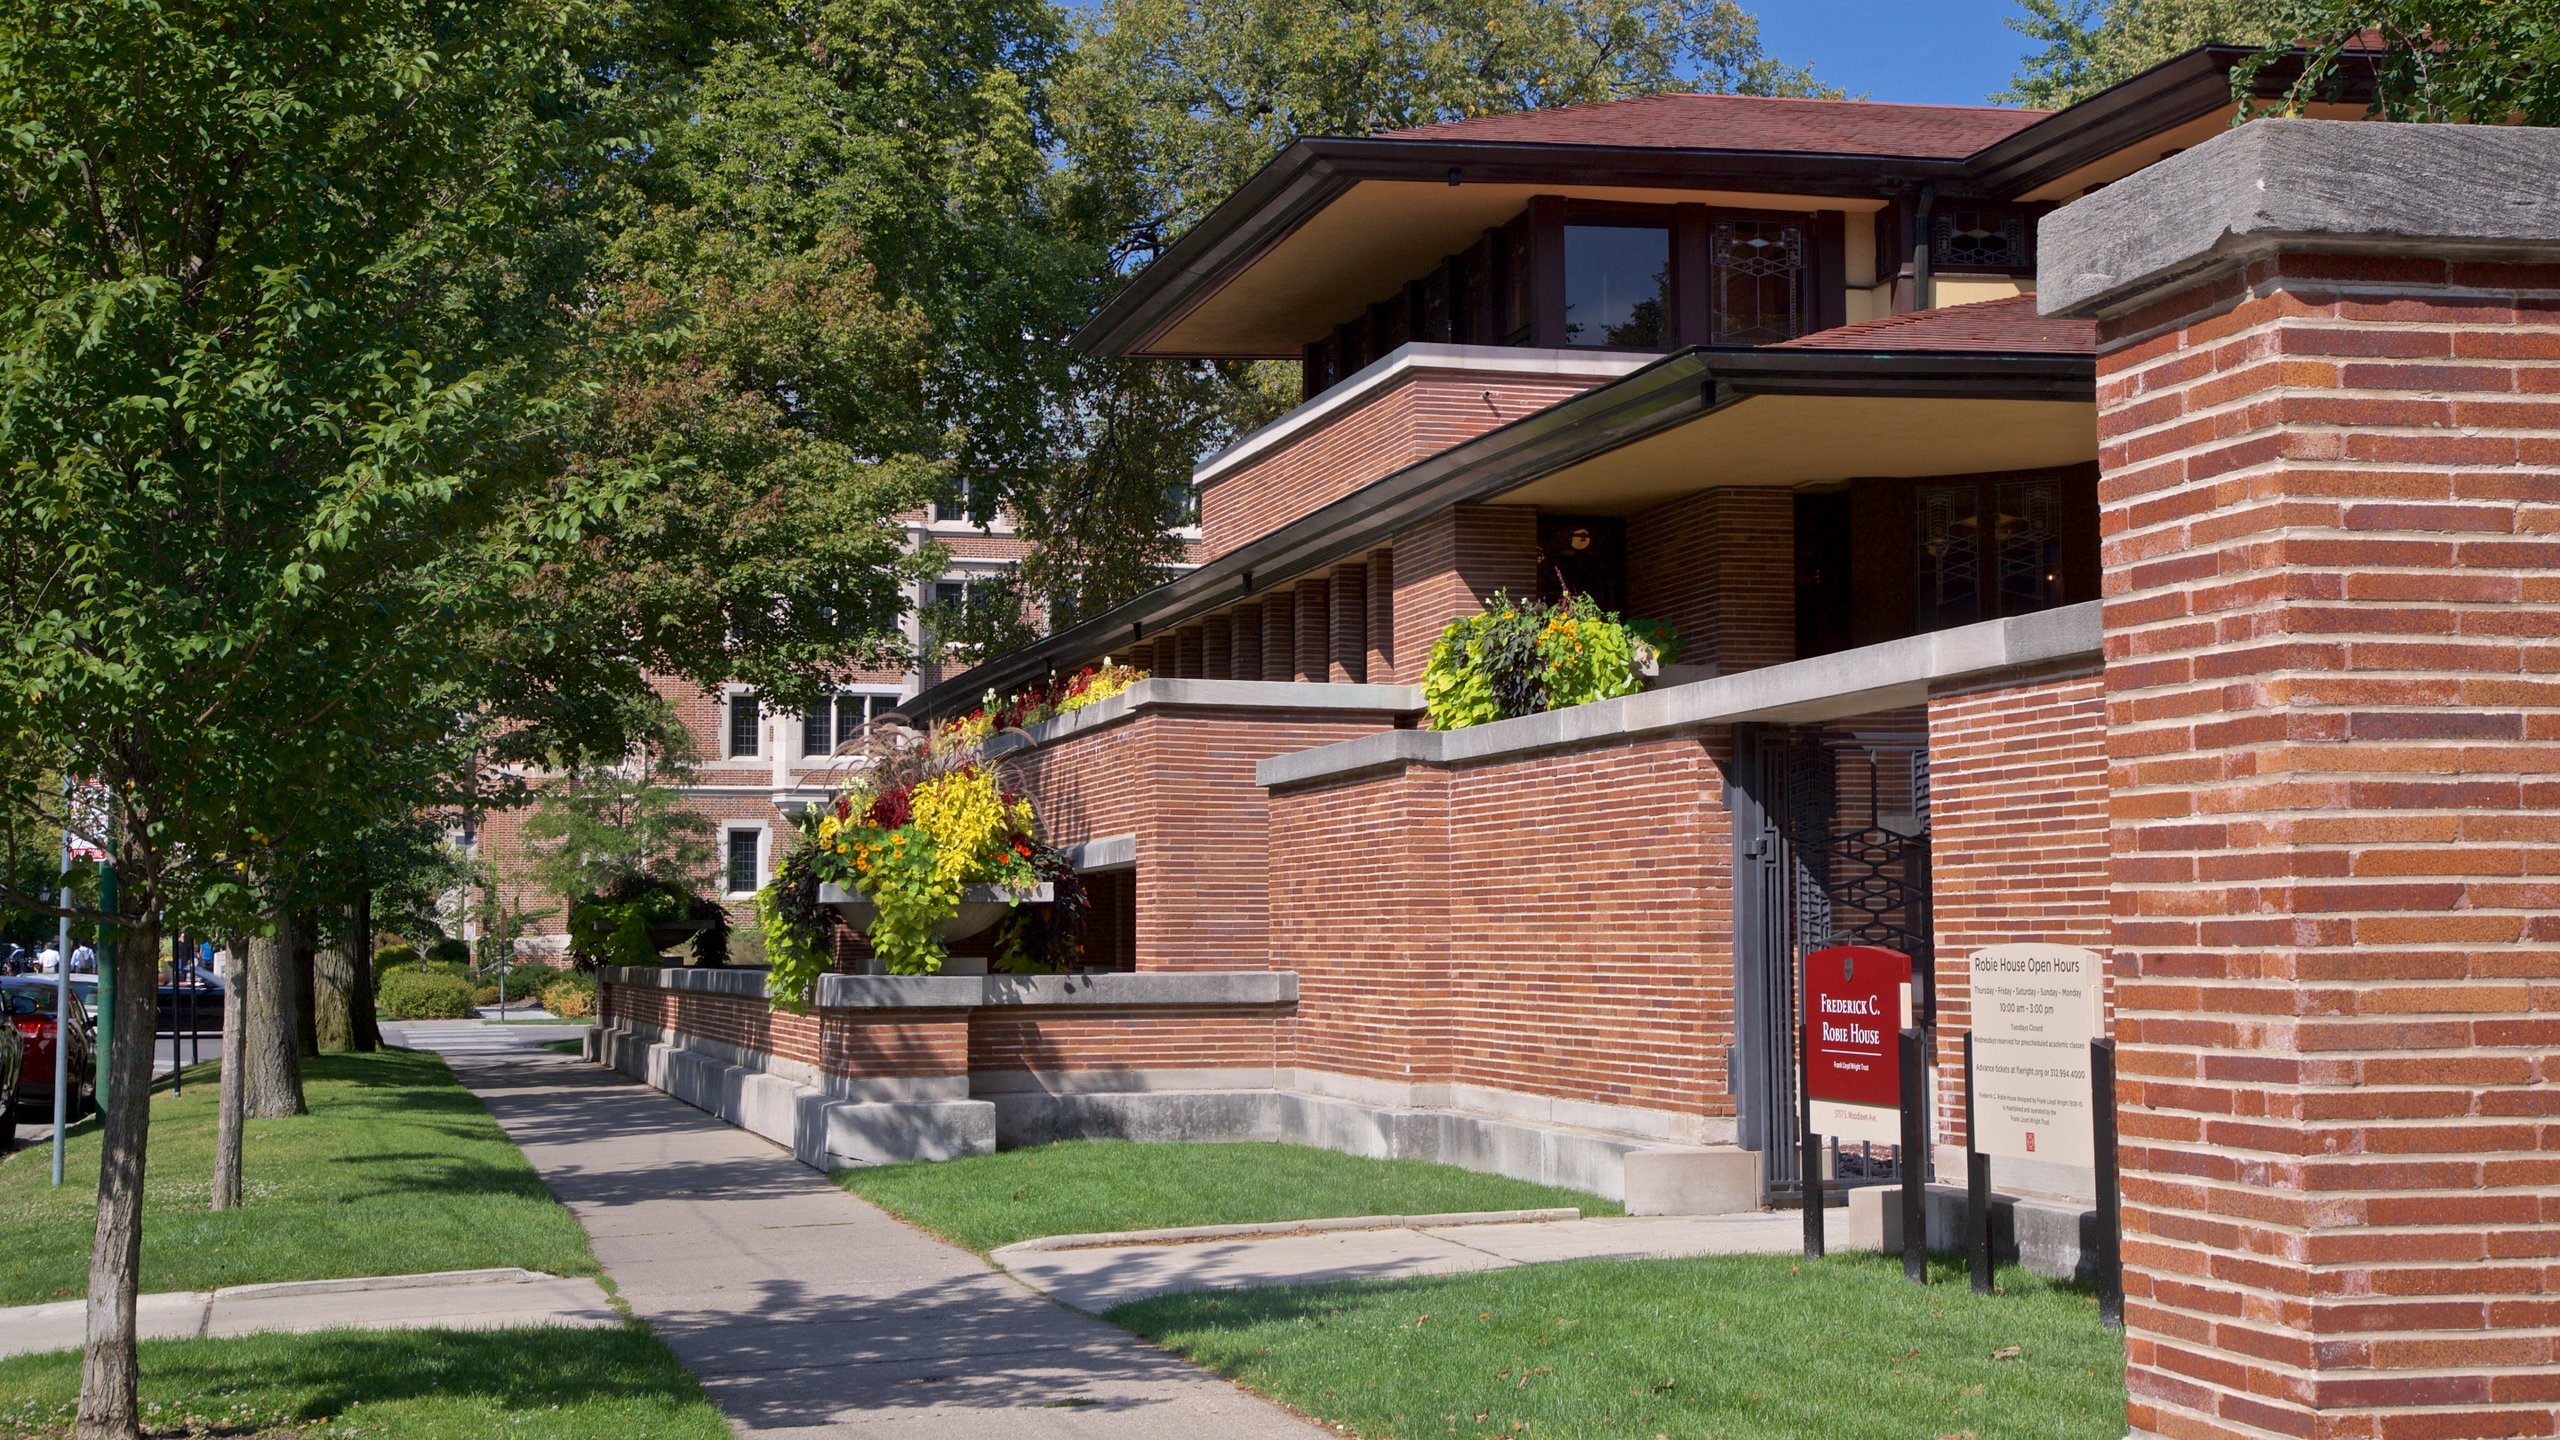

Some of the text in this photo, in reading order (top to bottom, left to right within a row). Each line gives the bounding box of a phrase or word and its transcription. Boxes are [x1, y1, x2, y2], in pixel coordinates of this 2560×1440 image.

[1975, 957, 2079, 975] Robie House Open Hours
[1975, 986, 1994, 996] Thursday
[1998, 987, 2011, 996] Friday
[2015, 987, 2036, 997] Saturday
[2040, 988, 2057, 997] Sunday
[2062, 989, 2081, 998] Monday
[1821, 994, 1880, 1015] FREDERICK C.
[2000, 1002, 2015, 1013] 10:00
[2016, 1005, 2025, 1013] am
[2030, 1003, 2043, 1014] 3:00
[2044, 1006, 2054, 1016] pm
[1823, 1022, 1880, 1044] ROBIE HOUSE
[2010, 1023, 2043, 1033] Tuesdays Closed
[1974, 1036, 1997, 1045] Wednesdays
[1997, 1038, 2014, 1046] reserved
[2021, 1039, 2048, 1048] prescheduled
[2048, 1041, 2069, 1049] academic
[2069, 1042, 2085, 1050] classes
[1976, 1064, 1994, 1073] Advance
[1995, 1064, 2010, 1074] tickets
[2010, 1066, 2016, 1074] at
[2044, 1069, 2050, 1077] or
